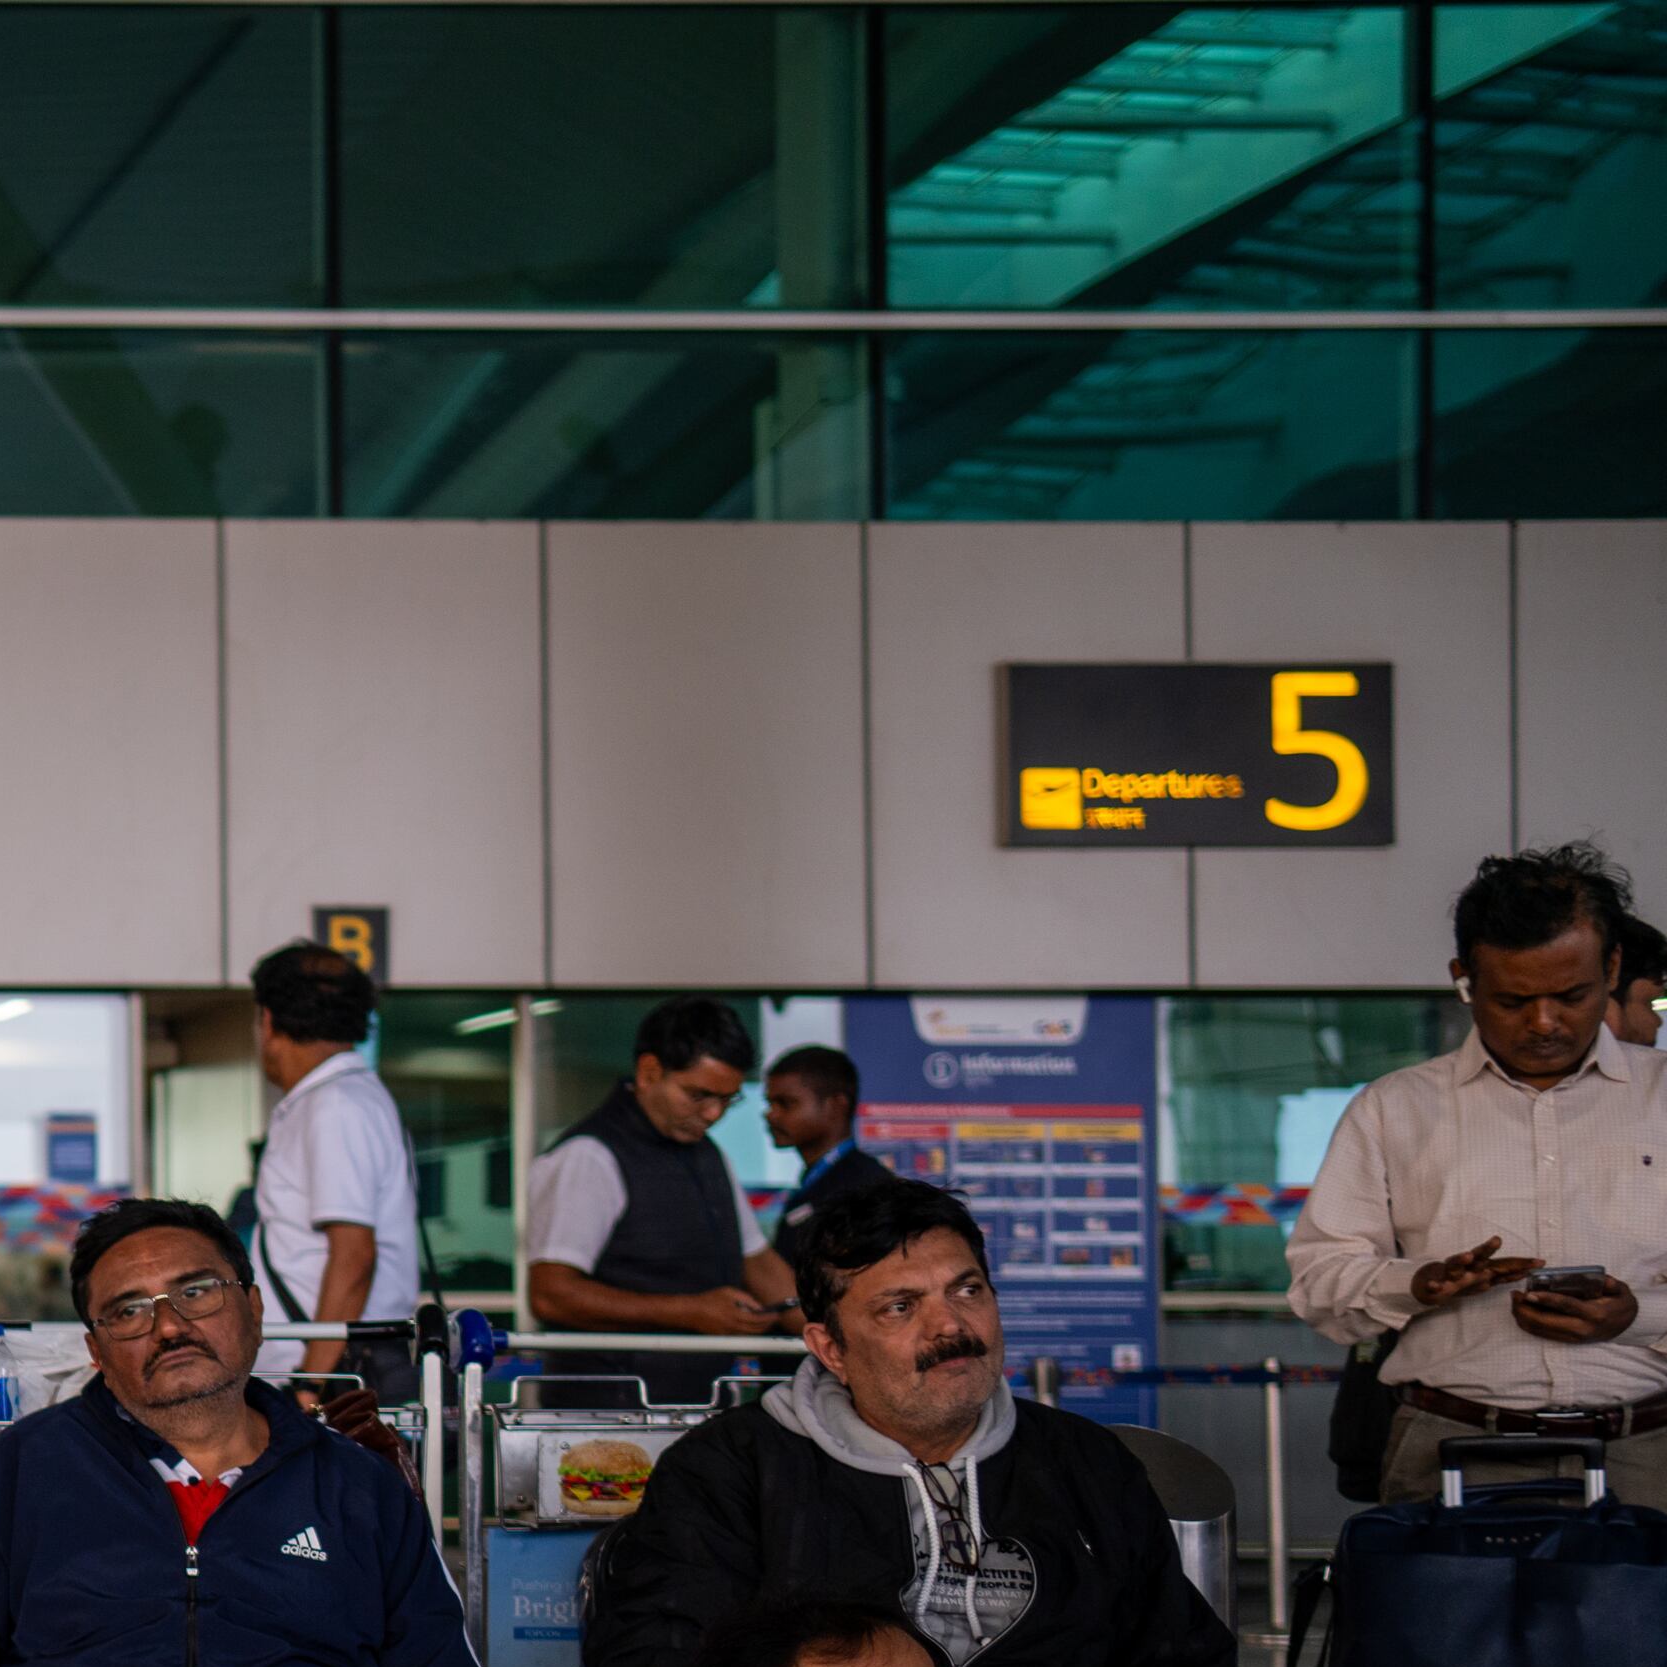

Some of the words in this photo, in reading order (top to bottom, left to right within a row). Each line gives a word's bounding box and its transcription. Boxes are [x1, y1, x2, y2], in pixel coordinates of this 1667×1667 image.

[1082, 767, 1244, 803] Departures
[1265, 671, 1369, 831] 5
[328, 914, 373, 973] B
[961, 1052, 1077, 1075] Information
[281, 1543, 327, 1562] adidas
[988, 1599, 1012, 1607] WAY
